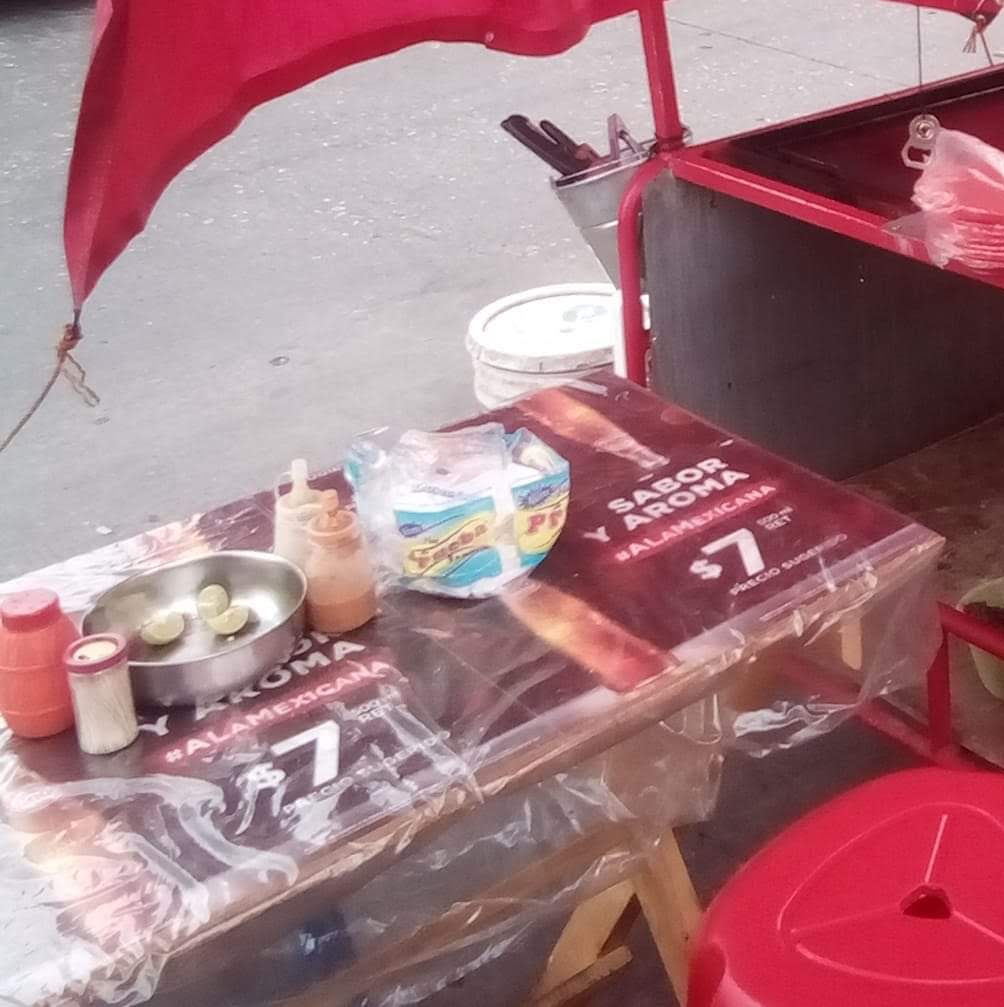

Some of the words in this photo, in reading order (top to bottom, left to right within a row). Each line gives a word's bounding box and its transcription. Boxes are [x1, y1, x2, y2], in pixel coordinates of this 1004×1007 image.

[582, 525, 611, 544] Y
[622, 468, 750, 532] AROMA
[607, 456, 728, 514] SABOR
[614, 483, 777, 563] #ALAMEXICANA
[689, 526, 766, 581] $7
[729, 566, 781, 596] PRECIO
